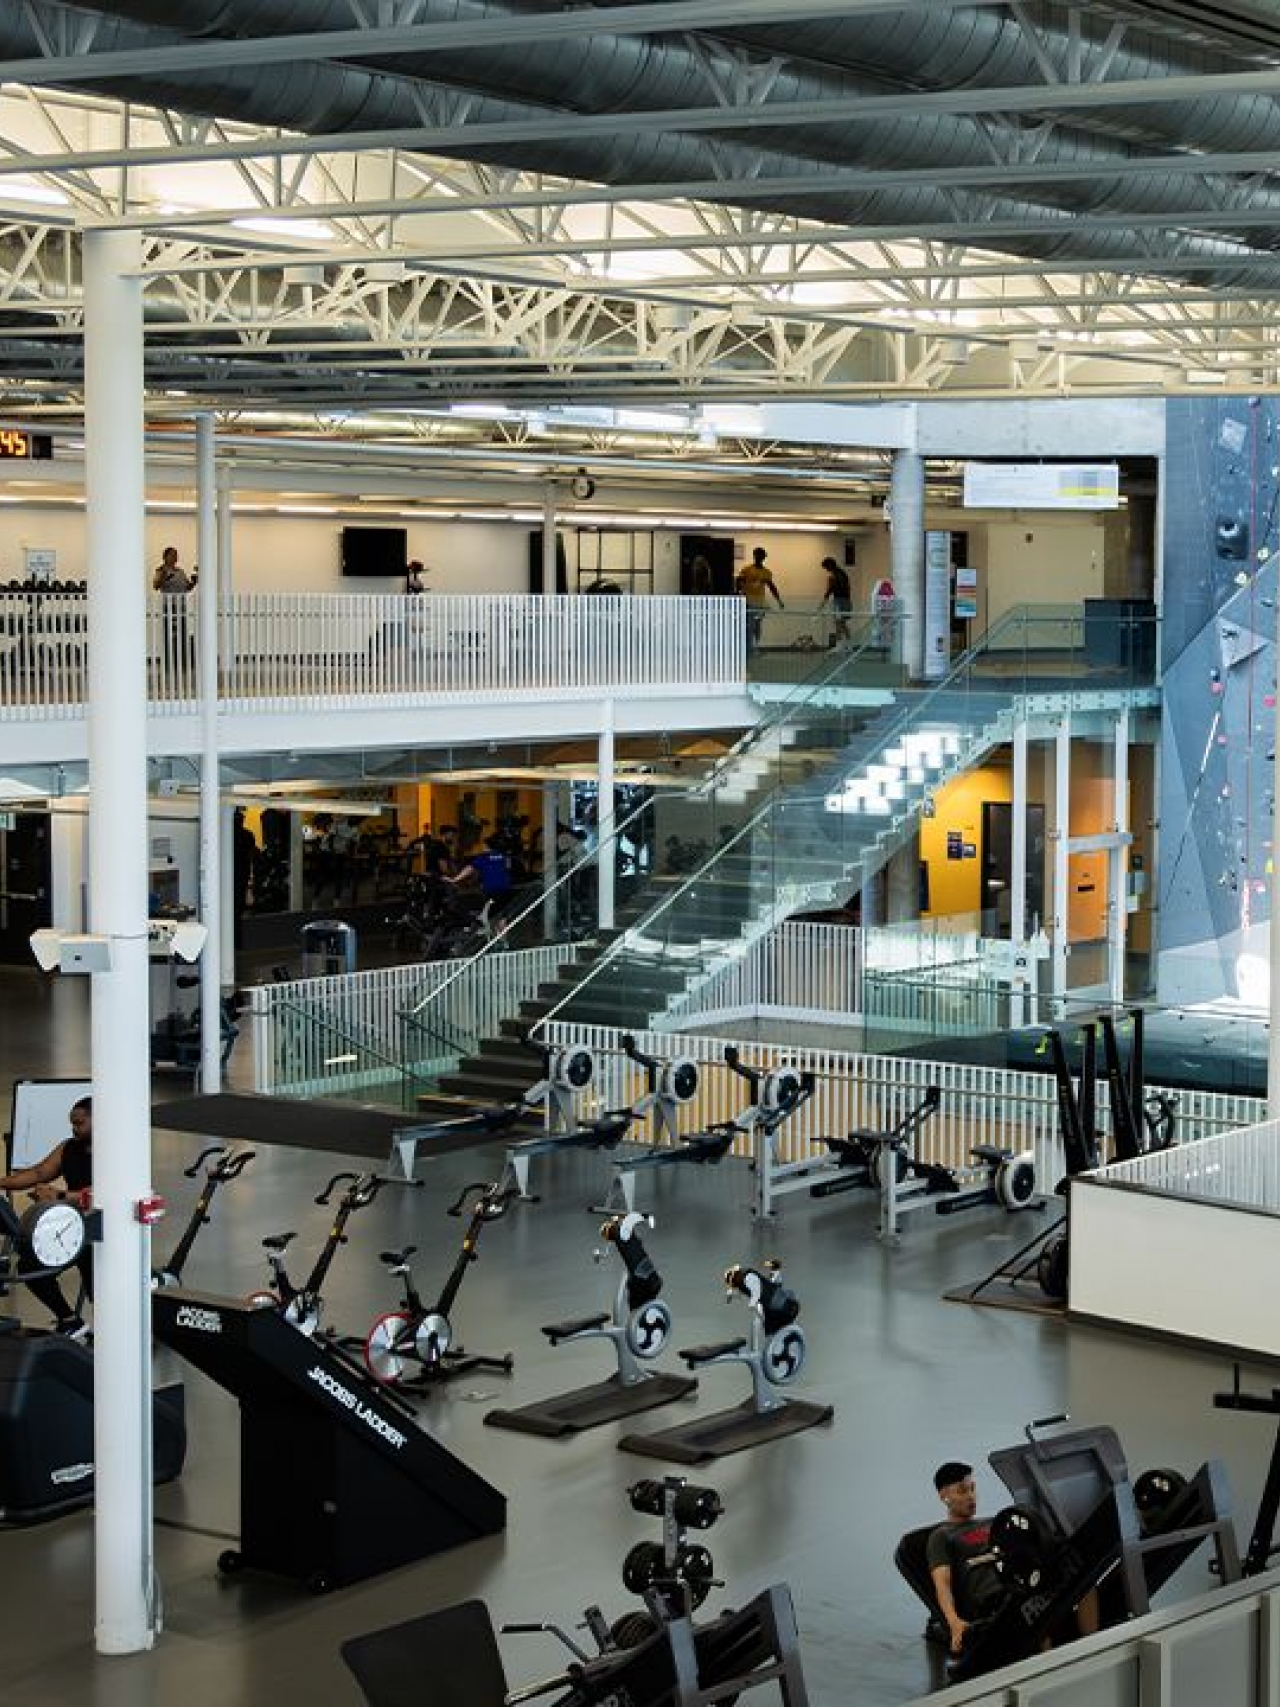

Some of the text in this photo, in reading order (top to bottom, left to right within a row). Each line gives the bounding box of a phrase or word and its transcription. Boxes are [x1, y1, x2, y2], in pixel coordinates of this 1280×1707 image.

[177, 1313, 222, 1333] LADDER
[307, 1366, 406, 1449] JACOBS LADDER
